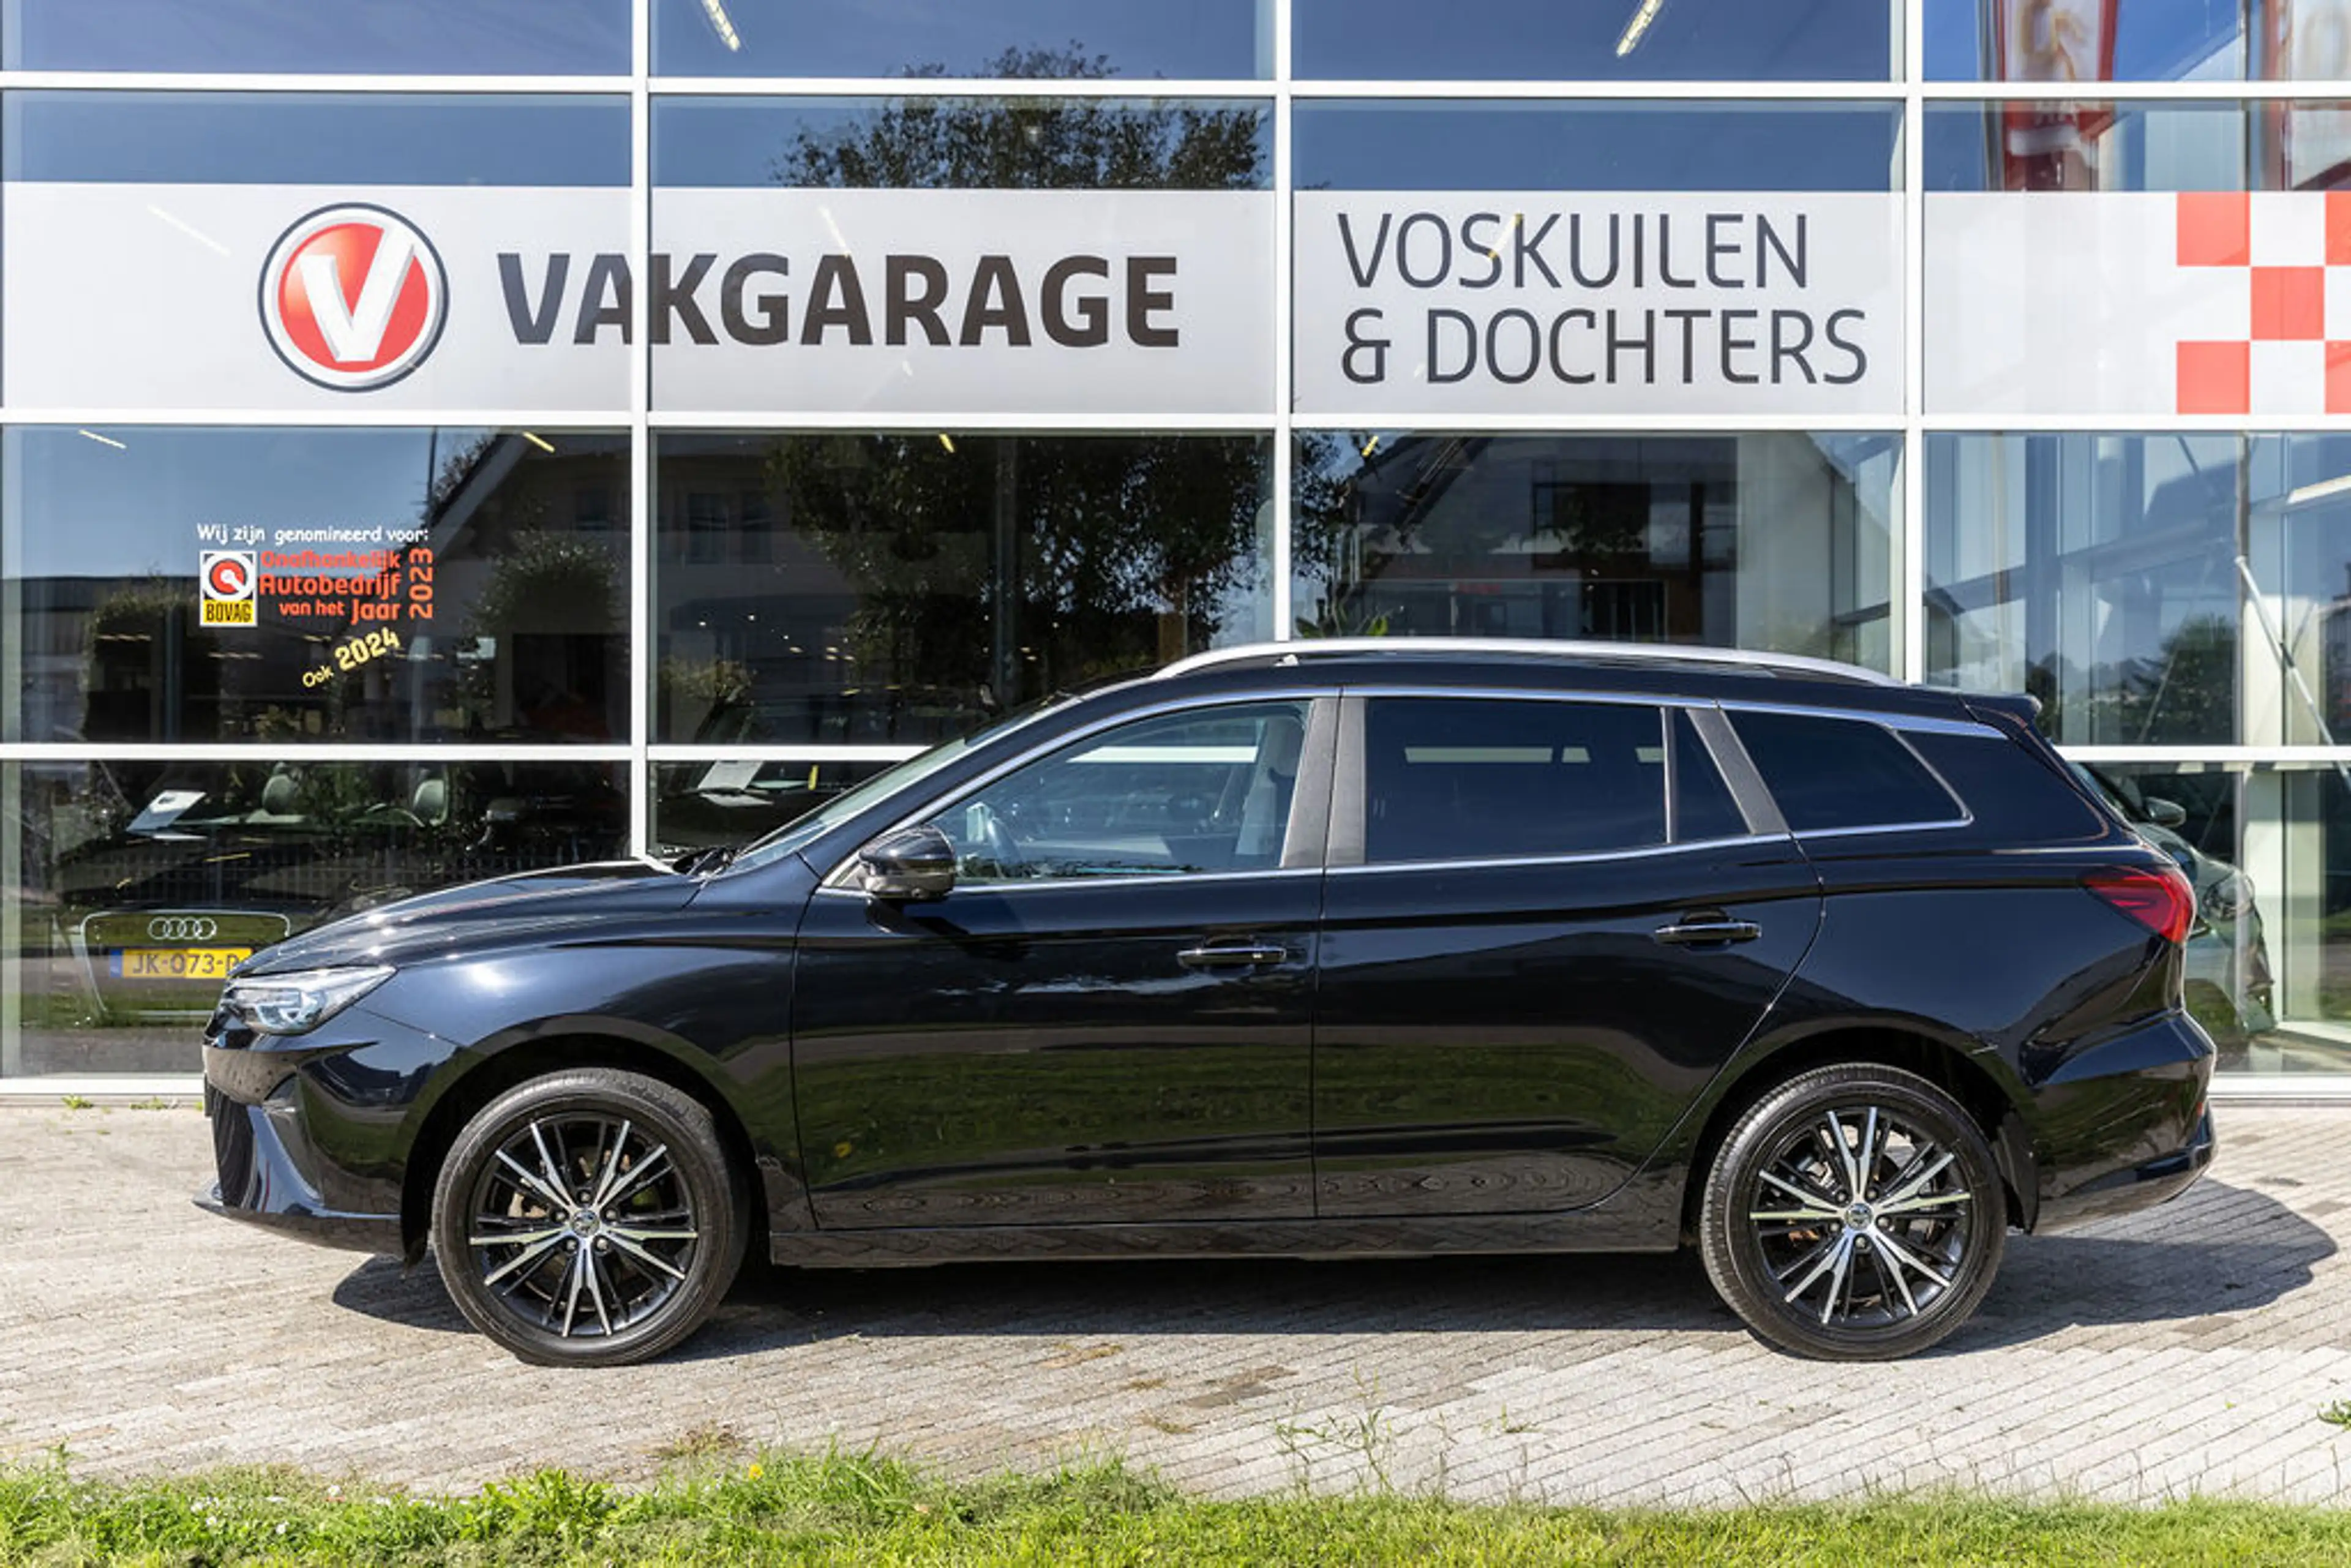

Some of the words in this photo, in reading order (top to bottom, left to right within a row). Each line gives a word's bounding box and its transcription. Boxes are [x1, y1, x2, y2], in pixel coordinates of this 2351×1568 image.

[1337, 213, 1808, 289] VOSKUILEN
[497, 252, 1179, 347] VAKGARAGE
[1341, 308, 1392, 384] &
[1427, 308, 1868, 384] DOCHTERS
[197, 523, 228, 546] Wij
[233, 525, 265, 546] zijn
[275, 525, 382, 546] genomineerd
[385, 529, 429, 542] voor:
[260, 550, 401, 571] Onafhankelijk
[259, 573, 401, 600] Autobedrijf
[408, 548, 433, 620] 2023
[206, 602, 252, 622] BOVAG
[279, 601, 312, 616] van
[315, 599, 345, 616] het
[350, 598, 402, 626] Jaar
[302, 665, 334, 688] Ook
[334, 626, 400, 671] 2024
